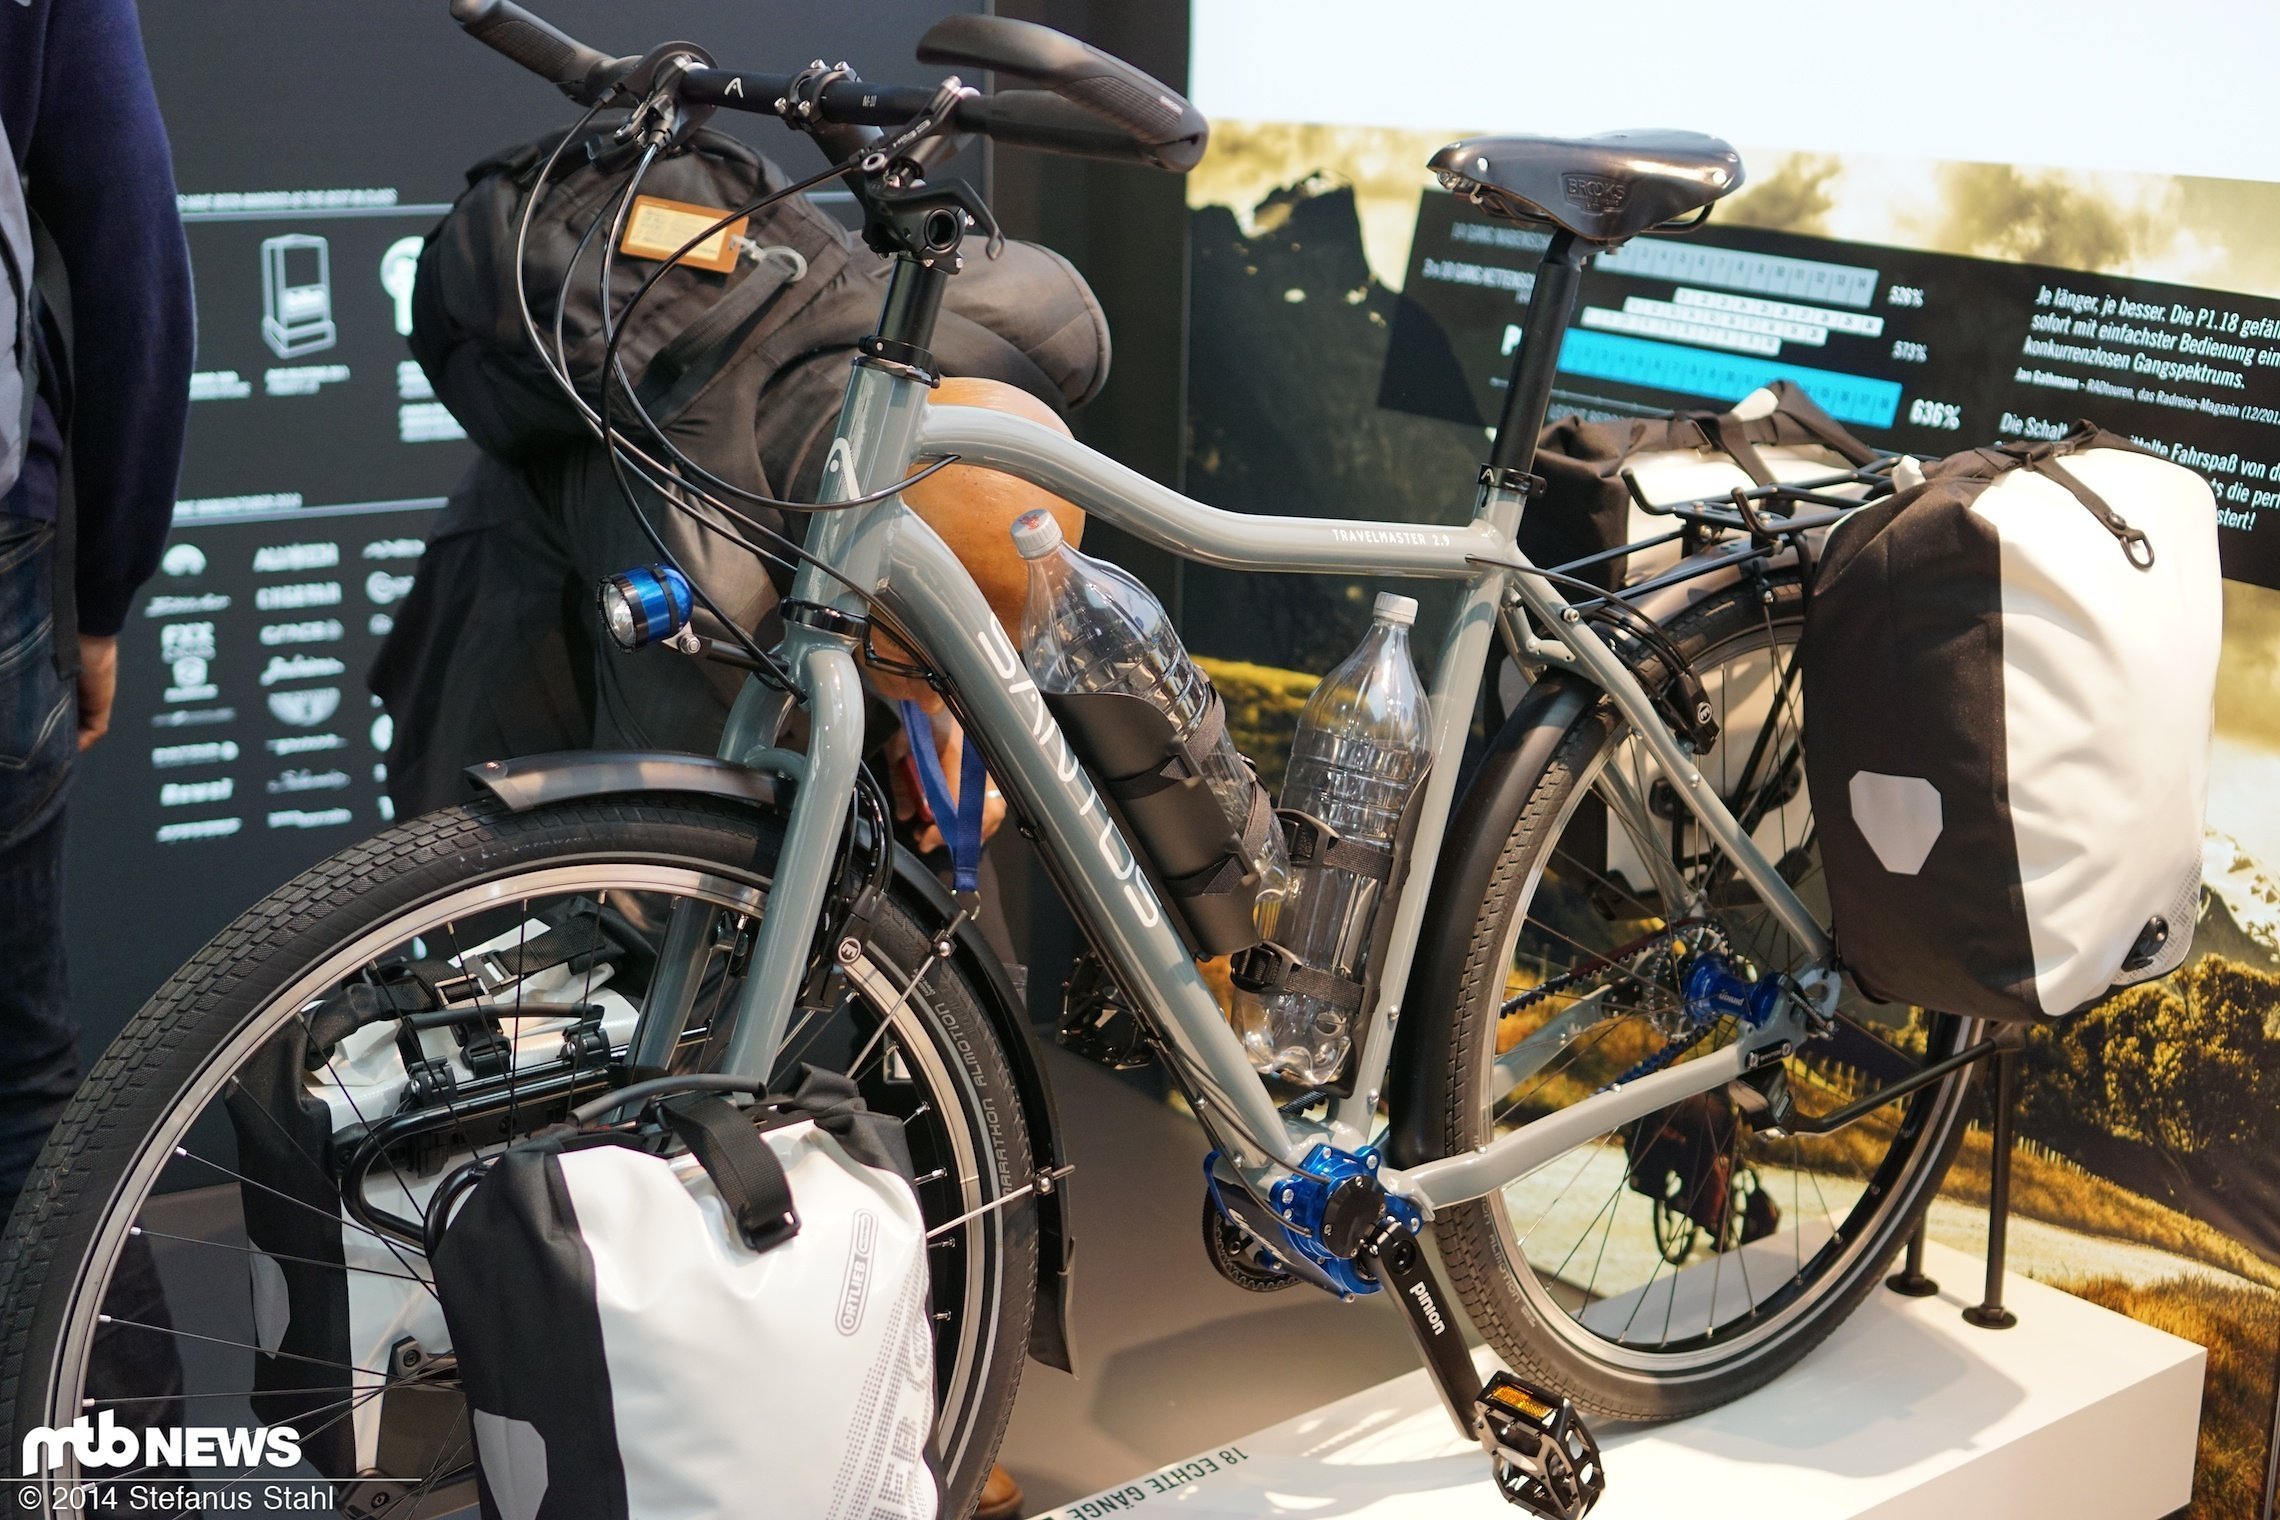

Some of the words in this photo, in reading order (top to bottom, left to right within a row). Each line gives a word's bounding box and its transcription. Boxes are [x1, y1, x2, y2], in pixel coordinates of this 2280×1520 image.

[1567, 178, 1626, 200] BROOKS
[2035, 285, 2053, 306] Je
[2053, 287, 2099, 315] länger,
[2100, 294, 2117, 318] je
[2118, 296, 2166, 322] besser.
[2170, 304, 2195, 326] Die
[2196, 308, 2240, 333] P1.18
[2031, 312, 2072, 335] sofort
[2072, 318, 2098, 339] mit
[2098, 321, 2178, 350] einfachster
[2179, 333, 2256, 366] Bedienung
[2022, 334, 2131, 369] konkurrenzlosen
[2132, 352, 2246, 389] Gangspektrums.
[1909, 398, 1962, 431] 636%
[2137, 387, 2156, 403] das
[2156, 389, 2240, 417] Radreise-Magazin
[1999, 412, 2023, 435] Die
[2170, 442, 2239, 474] Fahrspaß
[2241, 460, 2267, 479] von
[2227, 481, 2250, 503] die
[1331, 529, 1426, 545] TRAVELMASTER
[2217, 507, 2257, 531] stert!
[978, 612, 1162, 928] SANTOS
[935, 1002, 988, 1087] ALMOTION
[842, 1260, 868, 1328] ORTLIEB
[1408, 1280, 1446, 1336] pinion
[1219, 1447, 1249, 1466] 18
[1144, 1457, 1221, 1494] ECHTE
[1065, 1485, 1147, 1520] GÄNGE
